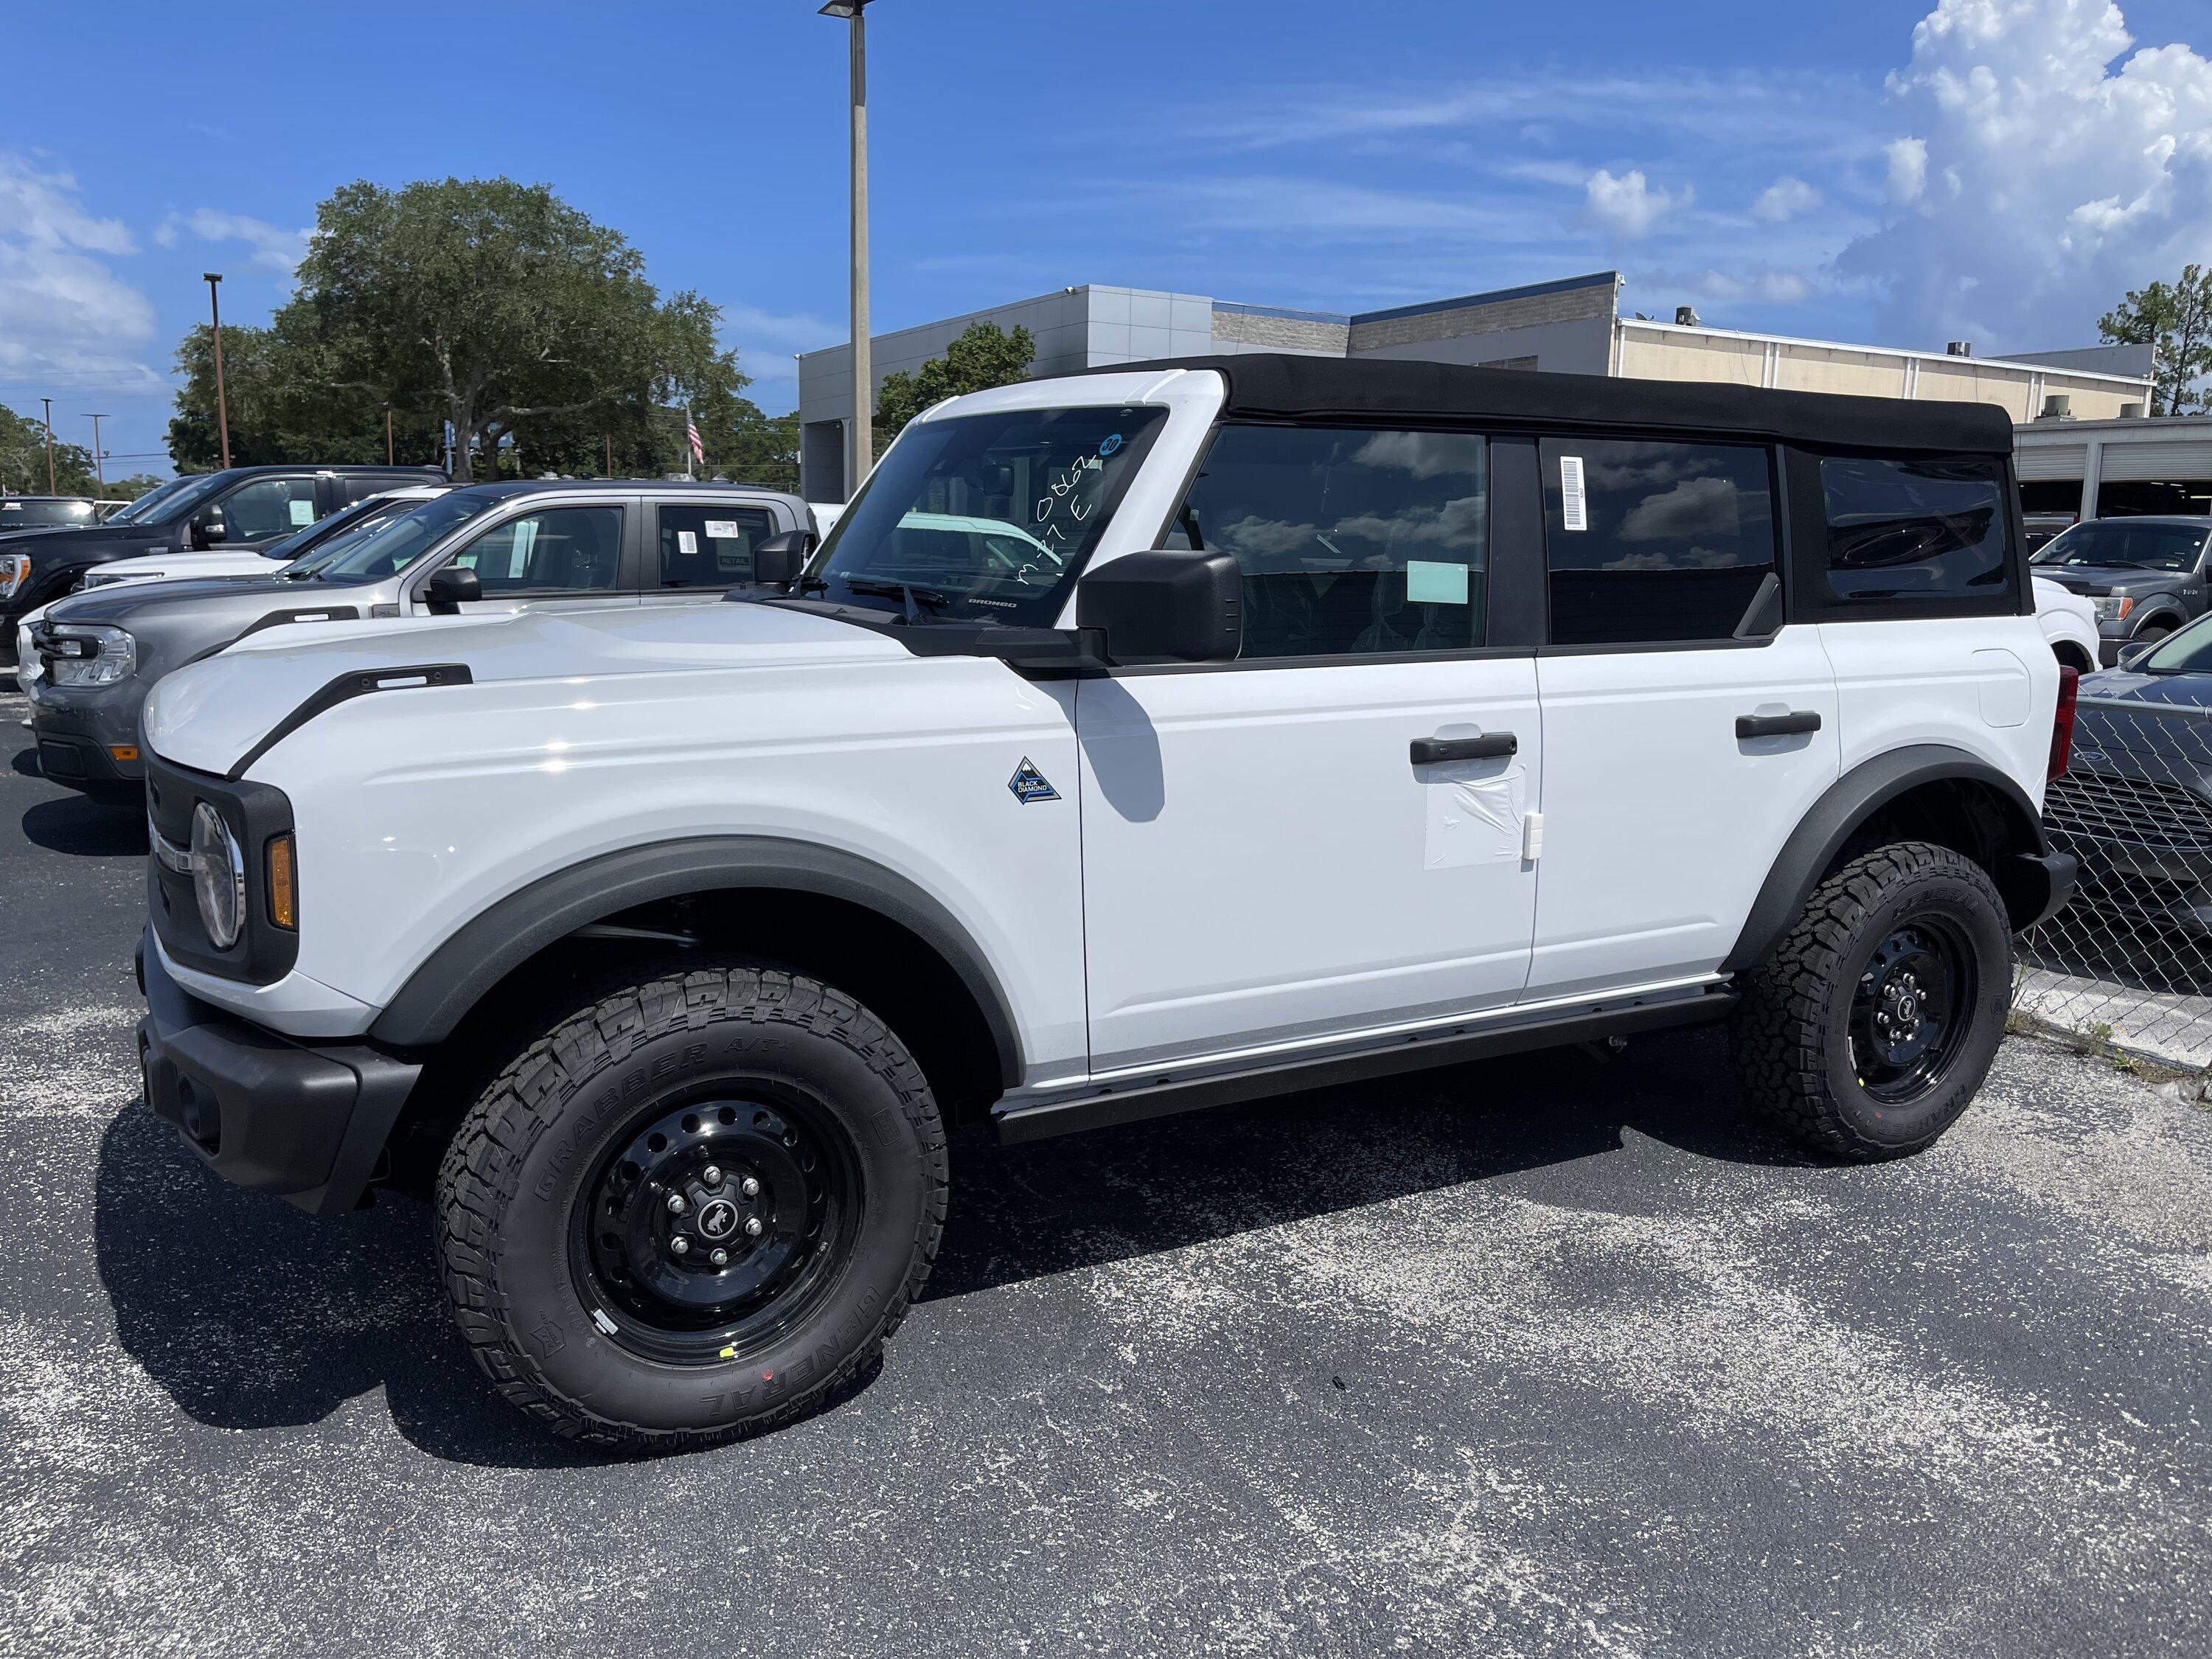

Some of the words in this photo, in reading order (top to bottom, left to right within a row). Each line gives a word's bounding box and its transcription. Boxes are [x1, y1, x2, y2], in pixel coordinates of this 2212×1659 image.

[1102, 438, 1119, 451] 30
[968, 598, 1018, 608] BRONCO
[1018, 785, 1047, 793] DIAMOND
[533, 1041, 708, 1203] GRABBER
[698, 1285, 880, 1416] GENERAL
